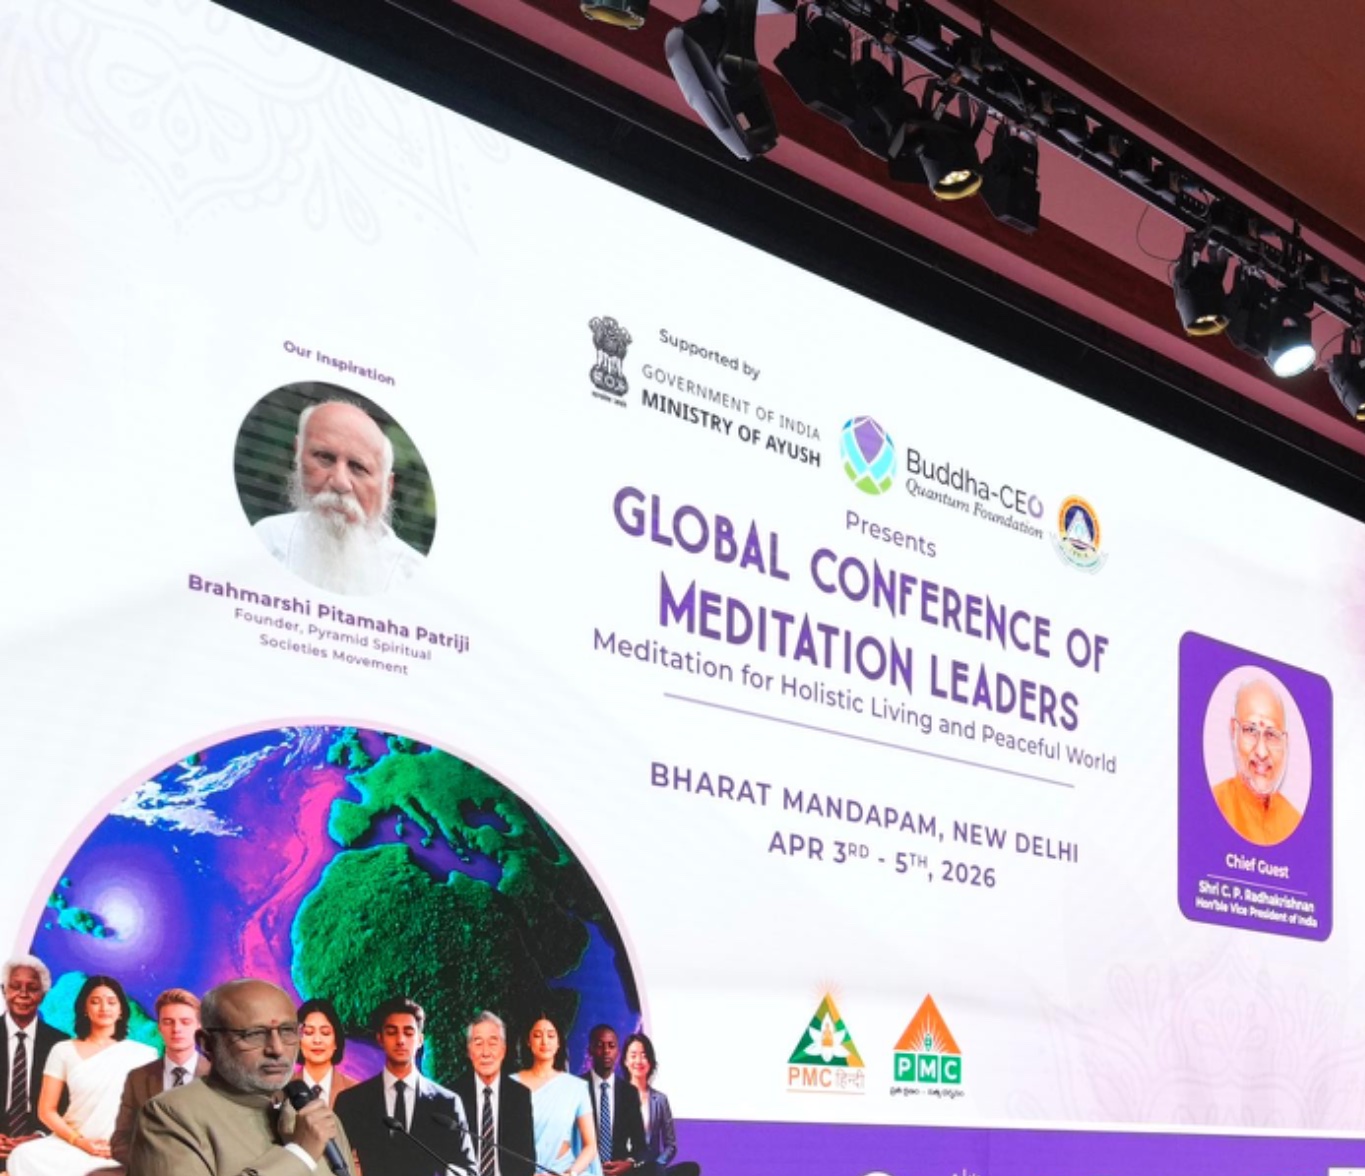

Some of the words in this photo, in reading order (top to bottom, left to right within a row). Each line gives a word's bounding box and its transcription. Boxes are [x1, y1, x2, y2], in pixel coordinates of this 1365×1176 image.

[283, 340, 312, 359] Our
[316, 350, 395, 386] Inspiration
[659, 328, 739, 371] Supported
[742, 361, 761, 381] by
[641, 363, 751, 419] GOVERNMENT
[755, 406, 775, 422] OF
[779, 414, 820, 440] INDIA
[641, 388, 734, 436] MINISTRY
[737, 424, 761, 445] OF
[765, 434, 821, 468] AYUSH
[905, 447, 1044, 519] Buddha-CEO
[905, 477, 970, 513] Quantum
[973, 500, 1044, 540] Foundation
[846, 509, 937, 558] Presents
[612, 485, 791, 582] GLOBAL
[810, 547, 1051, 659] CONFERENCE
[1066, 627, 1110, 674] OF
[188, 574, 311, 617] Brahmarshi
[317, 604, 409, 641] Pitamaha
[415, 625, 470, 654] Patriji
[234, 607, 303, 634] Founder,
[307, 624, 369, 652] Pyramid
[373, 638, 431, 660] Spiritual
[259, 629, 328, 658] Societies
[333, 650, 408, 676] Movement
[659, 571, 913, 695] MEDITATION
[931, 654, 1079, 732] LEADERS
[593, 627, 734, 682] Meditation
[740, 663, 774, 691] for
[781, 674, 864, 714] Holistic
[871, 696, 933, 735] Living
[938, 717, 976, 740] and
[982, 724, 1060, 761] Peaceful
[1066, 745, 1117, 774] World
[650, 761, 772, 807] BHARAT
[782, 787, 944, 843] MANDAPAM,
[953, 820, 1008, 850] NEW
[1015, 832, 1078, 863] DELHI
[767, 830, 824, 861] APR
[832, 840, 870, 864] 3RD
[941, 859, 996, 889] 2026
[1226, 854, 1256, 871] Chief
[1258, 860, 1290, 879] Guest
[1199, 880, 1220, 896] Shri
[1221, 885, 1231, 898] C.
[1233, 887, 1243, 900] P.
[1244, 889, 1315, 912] Radhakrishnan
[1230, 903, 1248, 916] Vice
[1289, 914, 1296, 924] of
[1298, 916, 1318, 928] India
[788, 1067, 832, 1087] PMC
[898, 1057, 958, 1081] PMC
